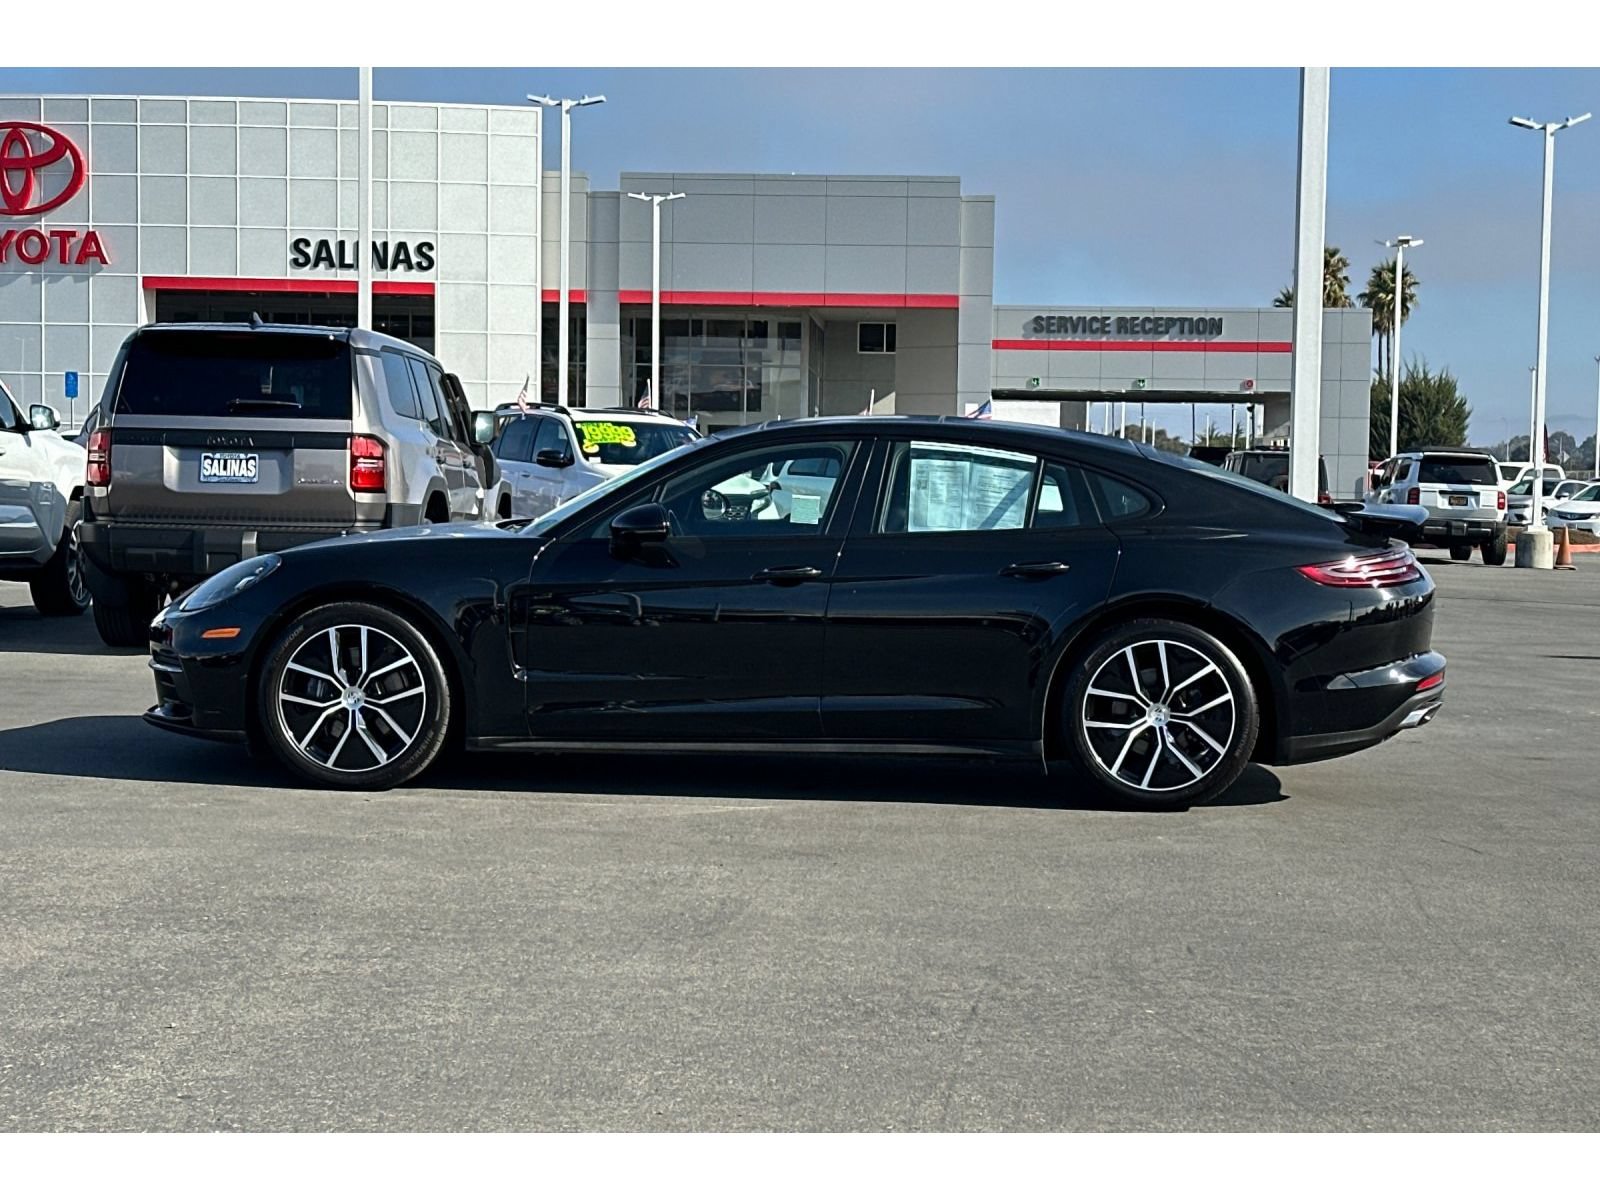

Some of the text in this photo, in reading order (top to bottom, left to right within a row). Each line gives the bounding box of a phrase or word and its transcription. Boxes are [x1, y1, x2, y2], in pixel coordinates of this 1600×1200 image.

[1032, 315, 1223, 337] SERVICE RECEPTION
[203, 459, 256, 477] SALINAS
